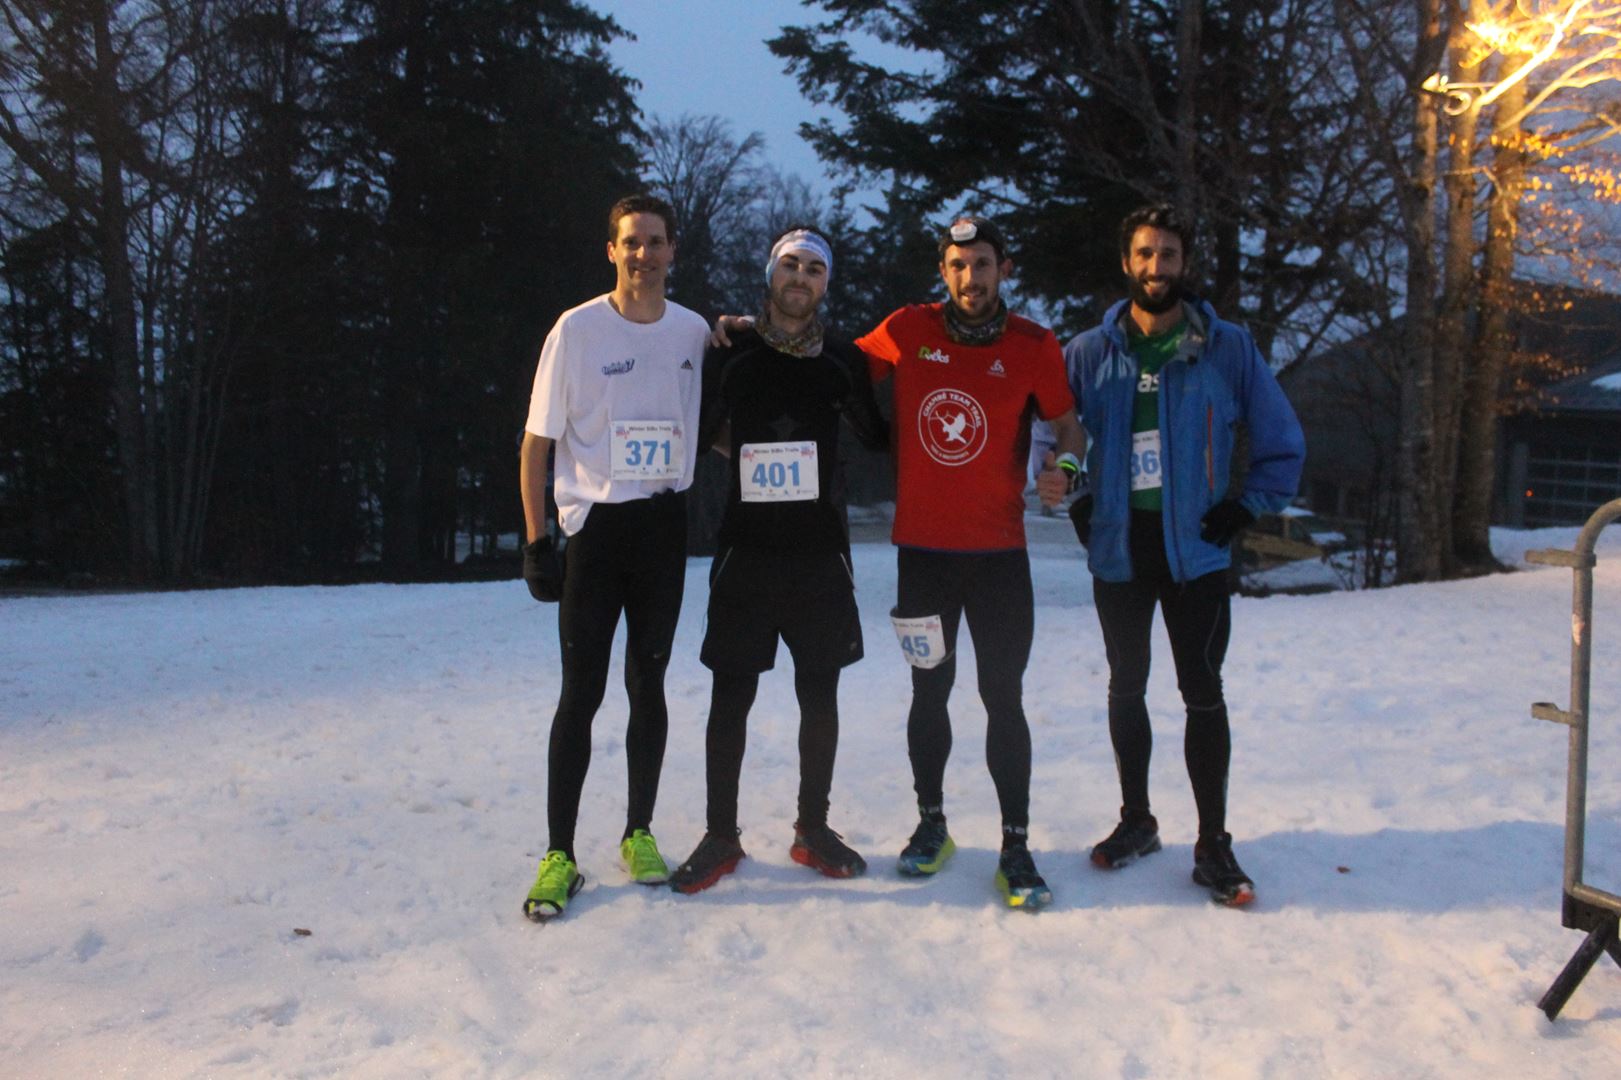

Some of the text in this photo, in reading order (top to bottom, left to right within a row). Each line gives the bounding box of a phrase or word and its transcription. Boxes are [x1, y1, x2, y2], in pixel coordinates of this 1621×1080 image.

[948, 392, 972, 407] TEAM
[625, 440, 671, 466] 371
[752, 461, 800, 488] 401
[901, 635, 930, 657] 45
